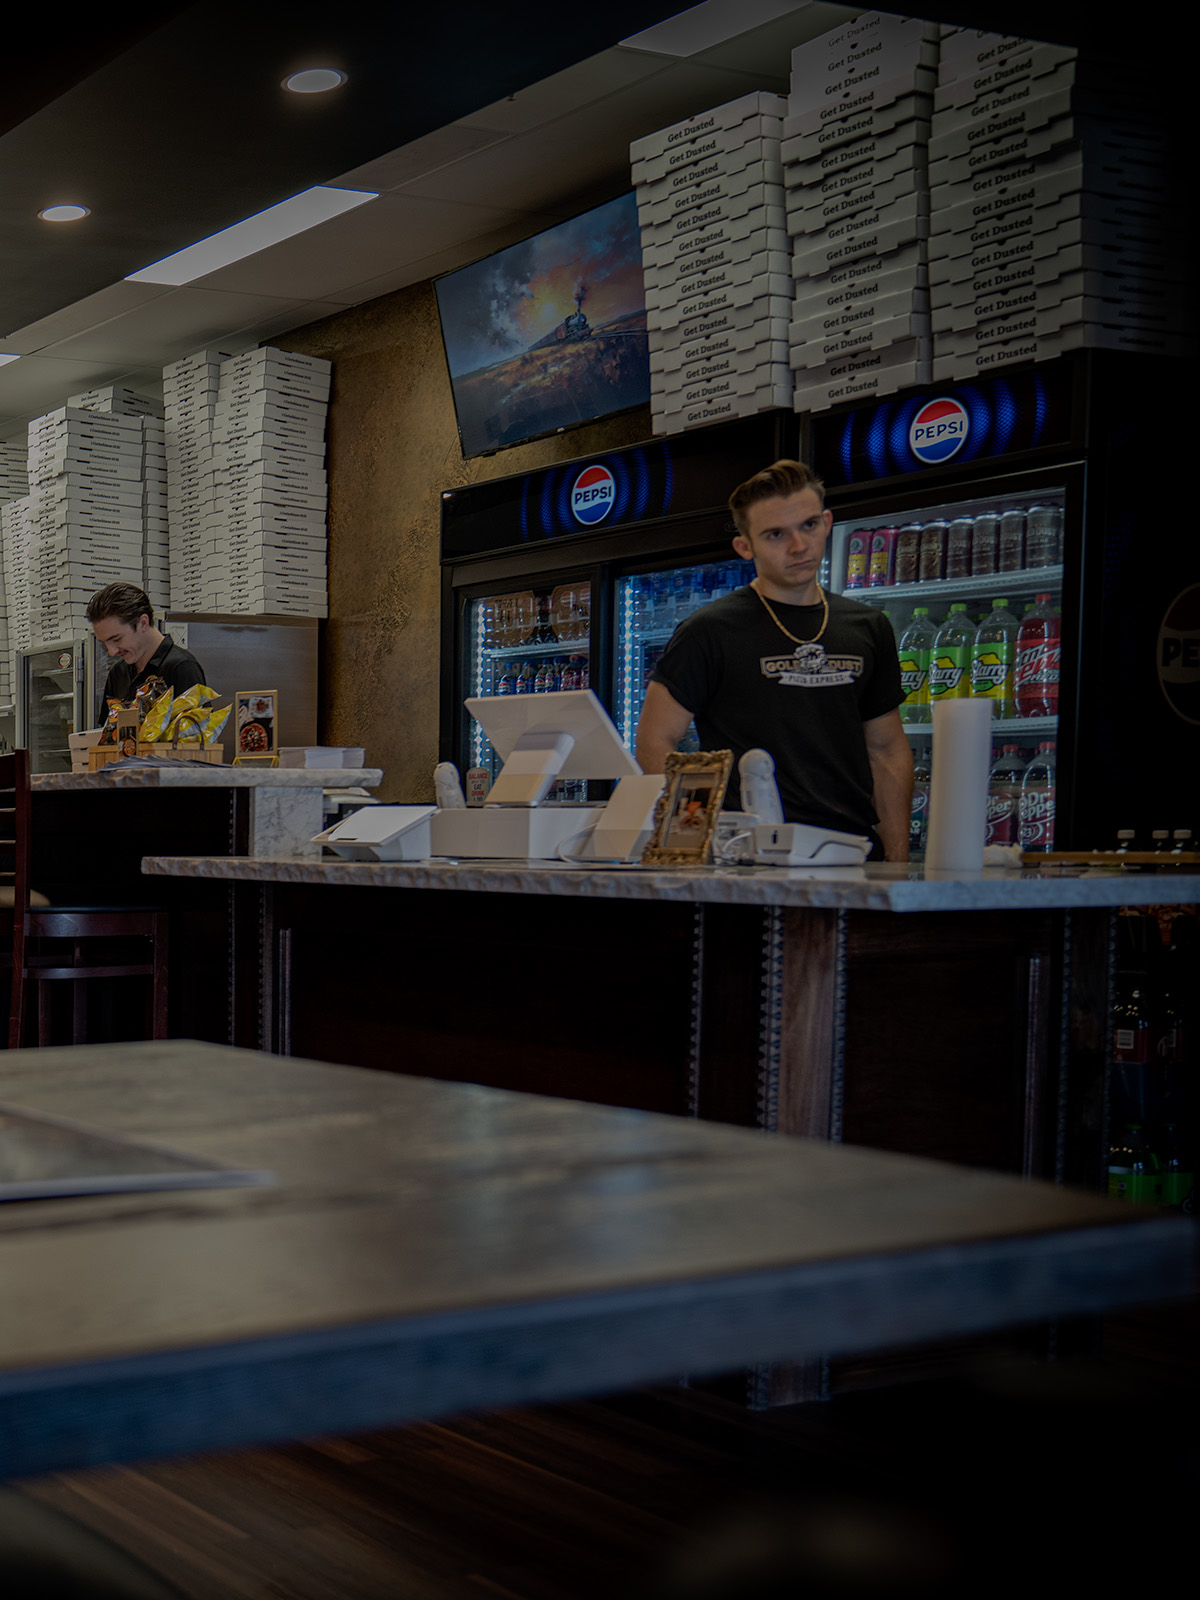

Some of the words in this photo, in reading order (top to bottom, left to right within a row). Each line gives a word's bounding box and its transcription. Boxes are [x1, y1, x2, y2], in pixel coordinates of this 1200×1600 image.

[829, 35, 844, 47] Get
[847, 17, 880, 39] Dusted
[828, 60, 845, 71] Get
[847, 42, 882, 63] Dusted
[977, 50, 995, 62] Get
[825, 83, 842, 95] Get
[845, 67, 880, 88] Dusted
[974, 76, 991, 89] Get
[994, 58, 1032, 80] Dusted
[820, 108, 837, 119] Get
[839, 91, 874, 112] Dusted
[972, 104, 989, 116] Get
[992, 87, 1030, 108] Dusted
[668, 131, 682, 142] Get
[684, 118, 714, 136] Dusted
[819, 131, 835, 143] Get
[838, 116, 873, 136] Dusted
[968, 129, 985, 140] Get
[988, 112, 1025, 133] Dusted
[669, 153, 684, 165] Get
[686, 140, 716, 158] Dusted
[822, 158, 838, 168] Get
[840, 143, 875, 161] Dusted
[969, 155, 986, 166] Get
[989, 139, 1027, 159] Dusted
[673, 175, 687, 187] Get
[689, 163, 718, 181] Dusted
[822, 182, 838, 192] Get
[840, 167, 874, 186] Dusted
[973, 180, 992, 191] Get
[995, 164, 1035, 184] Dusted
[675, 197, 690, 208] Get
[691, 185, 720, 203] Dusted
[823, 205, 839, 216] Get
[841, 191, 875, 209] Dusted
[973, 204, 991, 215] Get
[995, 189, 1034, 209] Dusted
[677, 219, 691, 229] Get
[693, 207, 721, 224] Dusted
[829, 227, 844, 238] Get
[847, 214, 879, 232] Dusted
[971, 230, 989, 241] Get
[992, 216, 1032, 235] Dusted
[679, 241, 693, 251] Get
[695, 229, 723, 246] Dusted
[827, 249, 842, 260] Get
[845, 236, 878, 254] Dusted
[680, 262, 694, 273] Get
[696, 251, 724, 268] Dusted
[972, 256, 990, 266] Get
[994, 241, 1034, 260] Dusted
[681, 283, 696, 293] Get
[698, 272, 725, 288] Dusted
[831, 273, 847, 283] Get
[849, 261, 882, 278] Dusted
[973, 279, 991, 290] Get
[995, 266, 1034, 285] Dusted
[683, 304, 697, 315] Get
[698, 294, 727, 310] Dusted
[827, 295, 843, 305] Get
[845, 284, 878, 300] Dusted
[975, 304, 993, 315] Get
[997, 291, 1036, 309] Dusted
[684, 326, 698, 336] Get
[700, 317, 727, 331] Dusted
[824, 318, 839, 329] Get
[842, 307, 874, 324] Dusted
[976, 329, 994, 340] Get
[998, 317, 1036, 335] Dusted
[686, 348, 700, 358] Get
[701, 339, 729, 354] Dusted
[824, 343, 839, 353] Get
[841, 332, 873, 348] Dusted
[976, 354, 994, 365] Get
[998, 344, 1037, 360] Dusted
[686, 369, 700, 379] Get
[702, 361, 729, 375] Dusted
[830, 366, 846, 376] Get
[848, 356, 881, 371] Dusted
[687, 390, 700, 400] Get
[702, 382, 729, 396] Dusted
[828, 389, 844, 398] Get
[846, 379, 878, 394] Dusted
[688, 411, 702, 421] Get
[703, 403, 731, 417] Dusted
[915, 421, 963, 441] PEPSI
[575, 486, 612, 504] PEPSI
[928, 662, 964, 689] Starry
[970, 660, 1010, 686] Starry
[1019, 797, 1056, 821] Peppe
[1028, 792, 1051, 806] Dr
